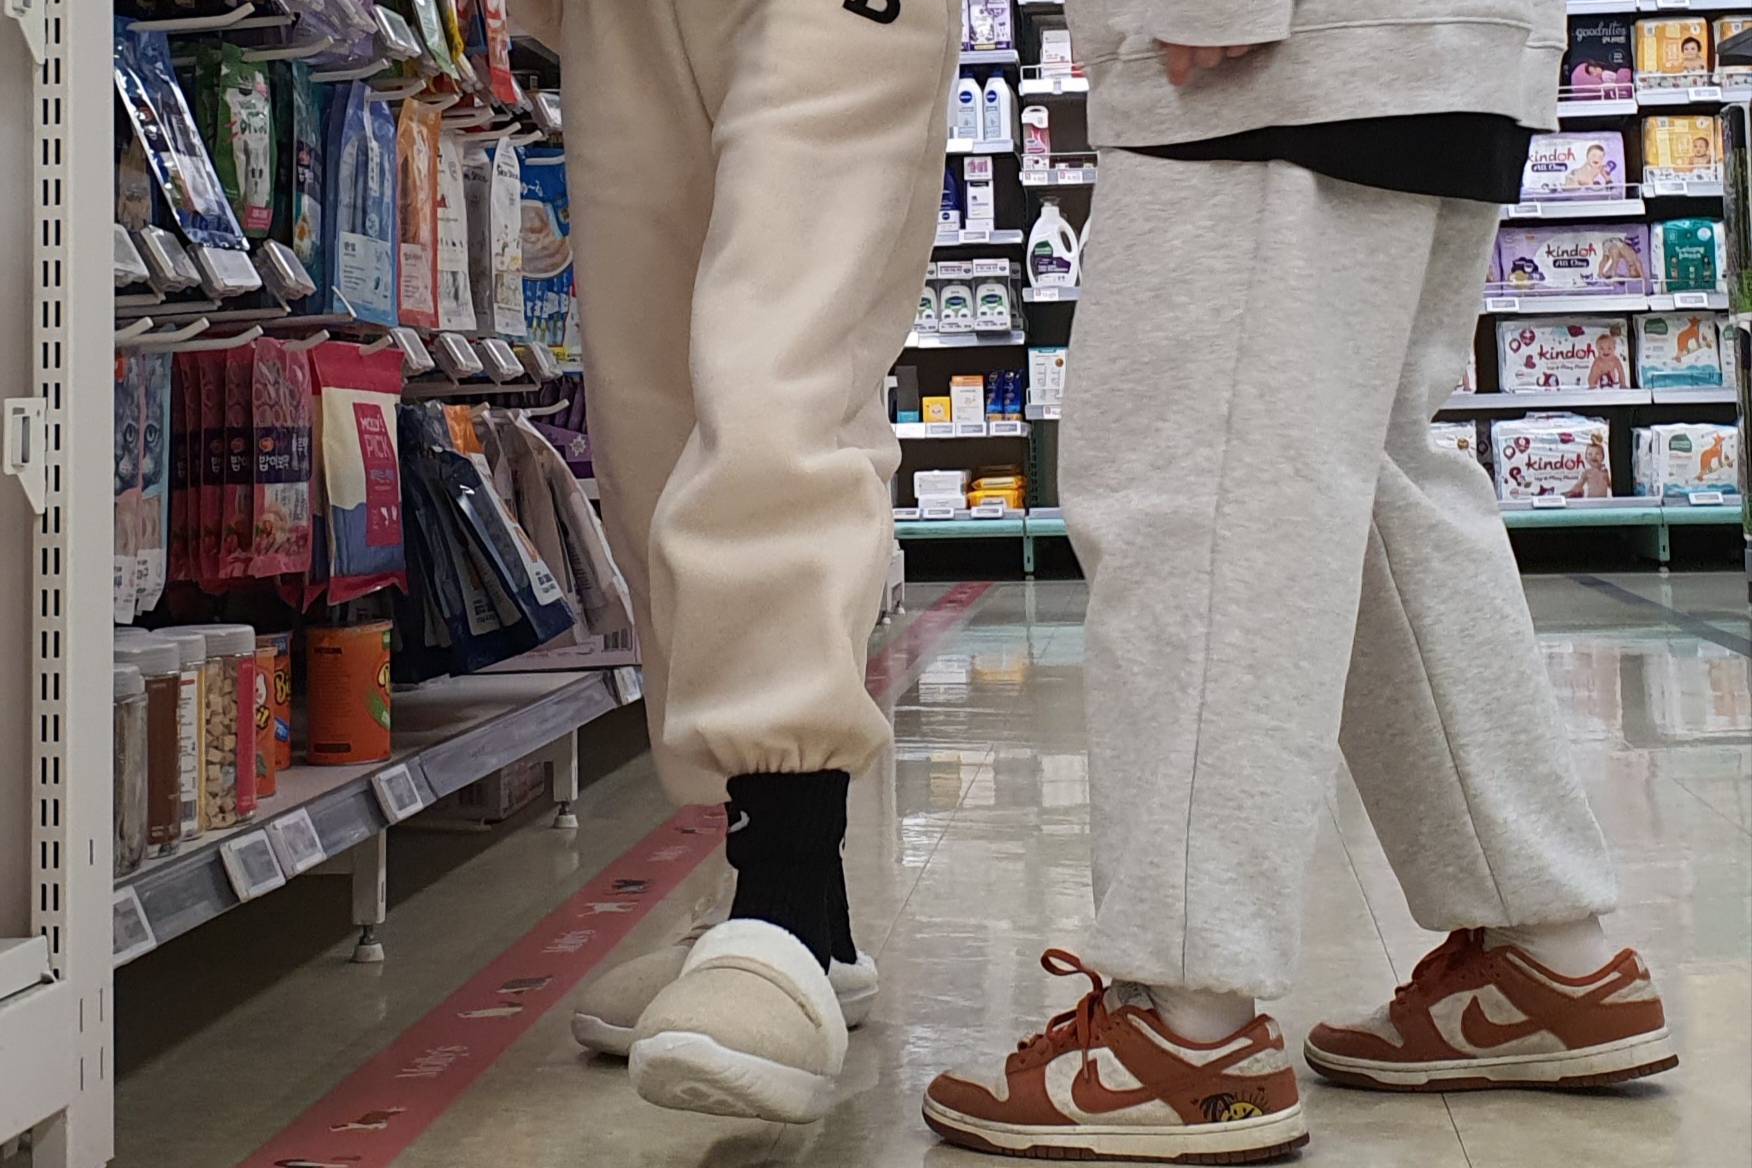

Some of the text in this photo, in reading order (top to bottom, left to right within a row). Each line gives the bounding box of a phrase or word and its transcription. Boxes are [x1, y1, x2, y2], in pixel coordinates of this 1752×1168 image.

[1575, 21, 1627, 43] goodnites
[1545, 242, 1597, 258] kindoh
[1537, 342, 1597, 361] kindoh
[363, 434, 394, 460] PICK
[1525, 453, 1587, 471] kindoh
